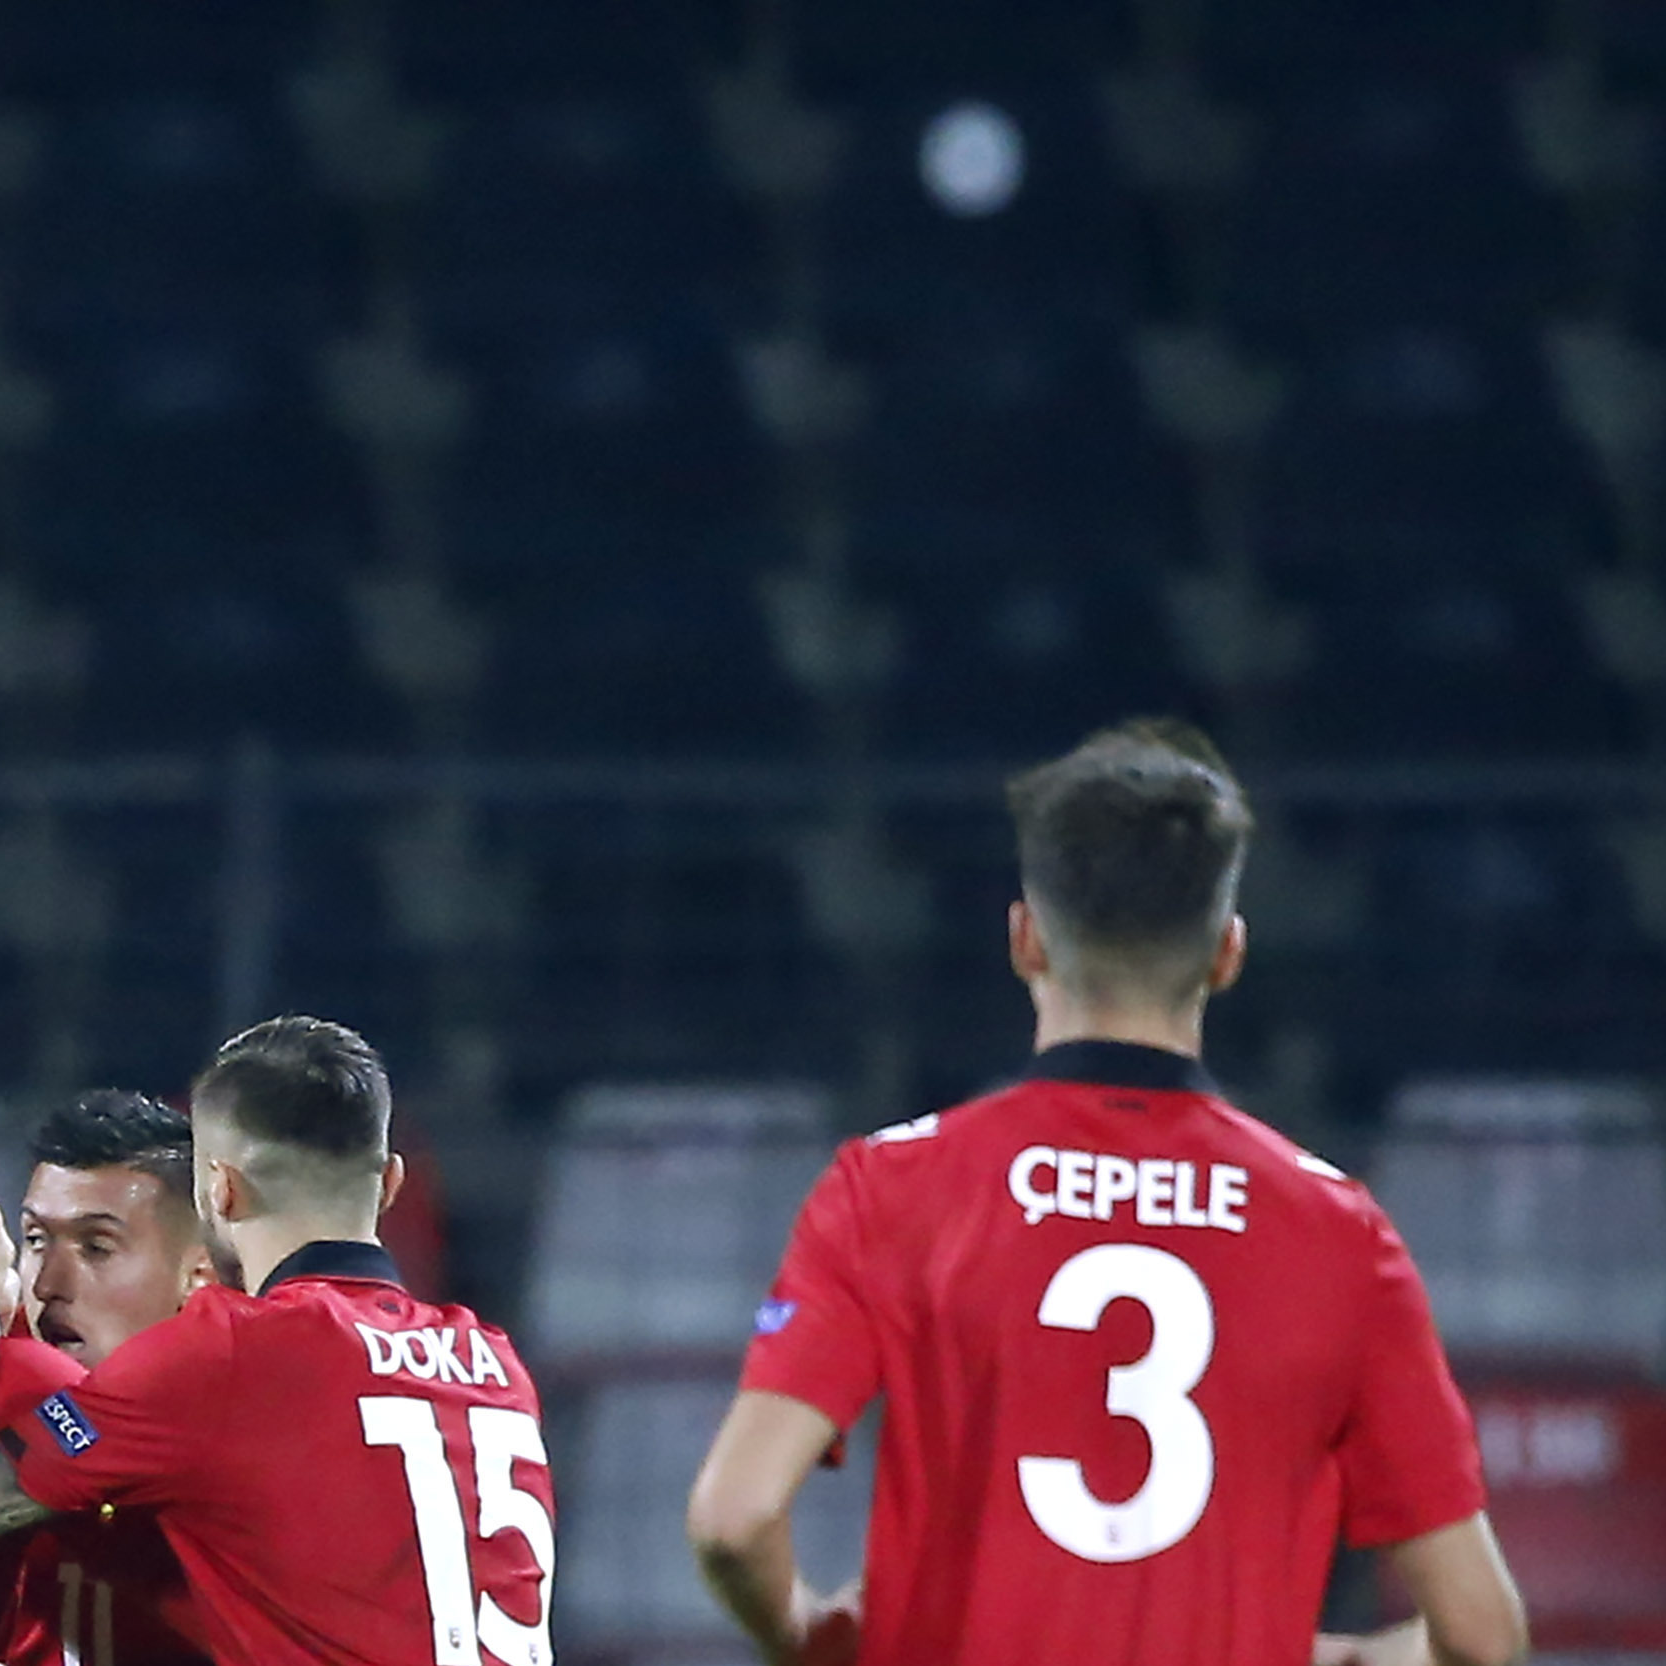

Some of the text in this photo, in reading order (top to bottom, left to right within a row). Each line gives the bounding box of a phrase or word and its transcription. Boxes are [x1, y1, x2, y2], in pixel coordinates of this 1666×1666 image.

[1007, 1145, 1250, 1234] ÇEPELE
[353, 1321, 511, 1388] DOKA
[1016, 1242, 1216, 1564] 3
